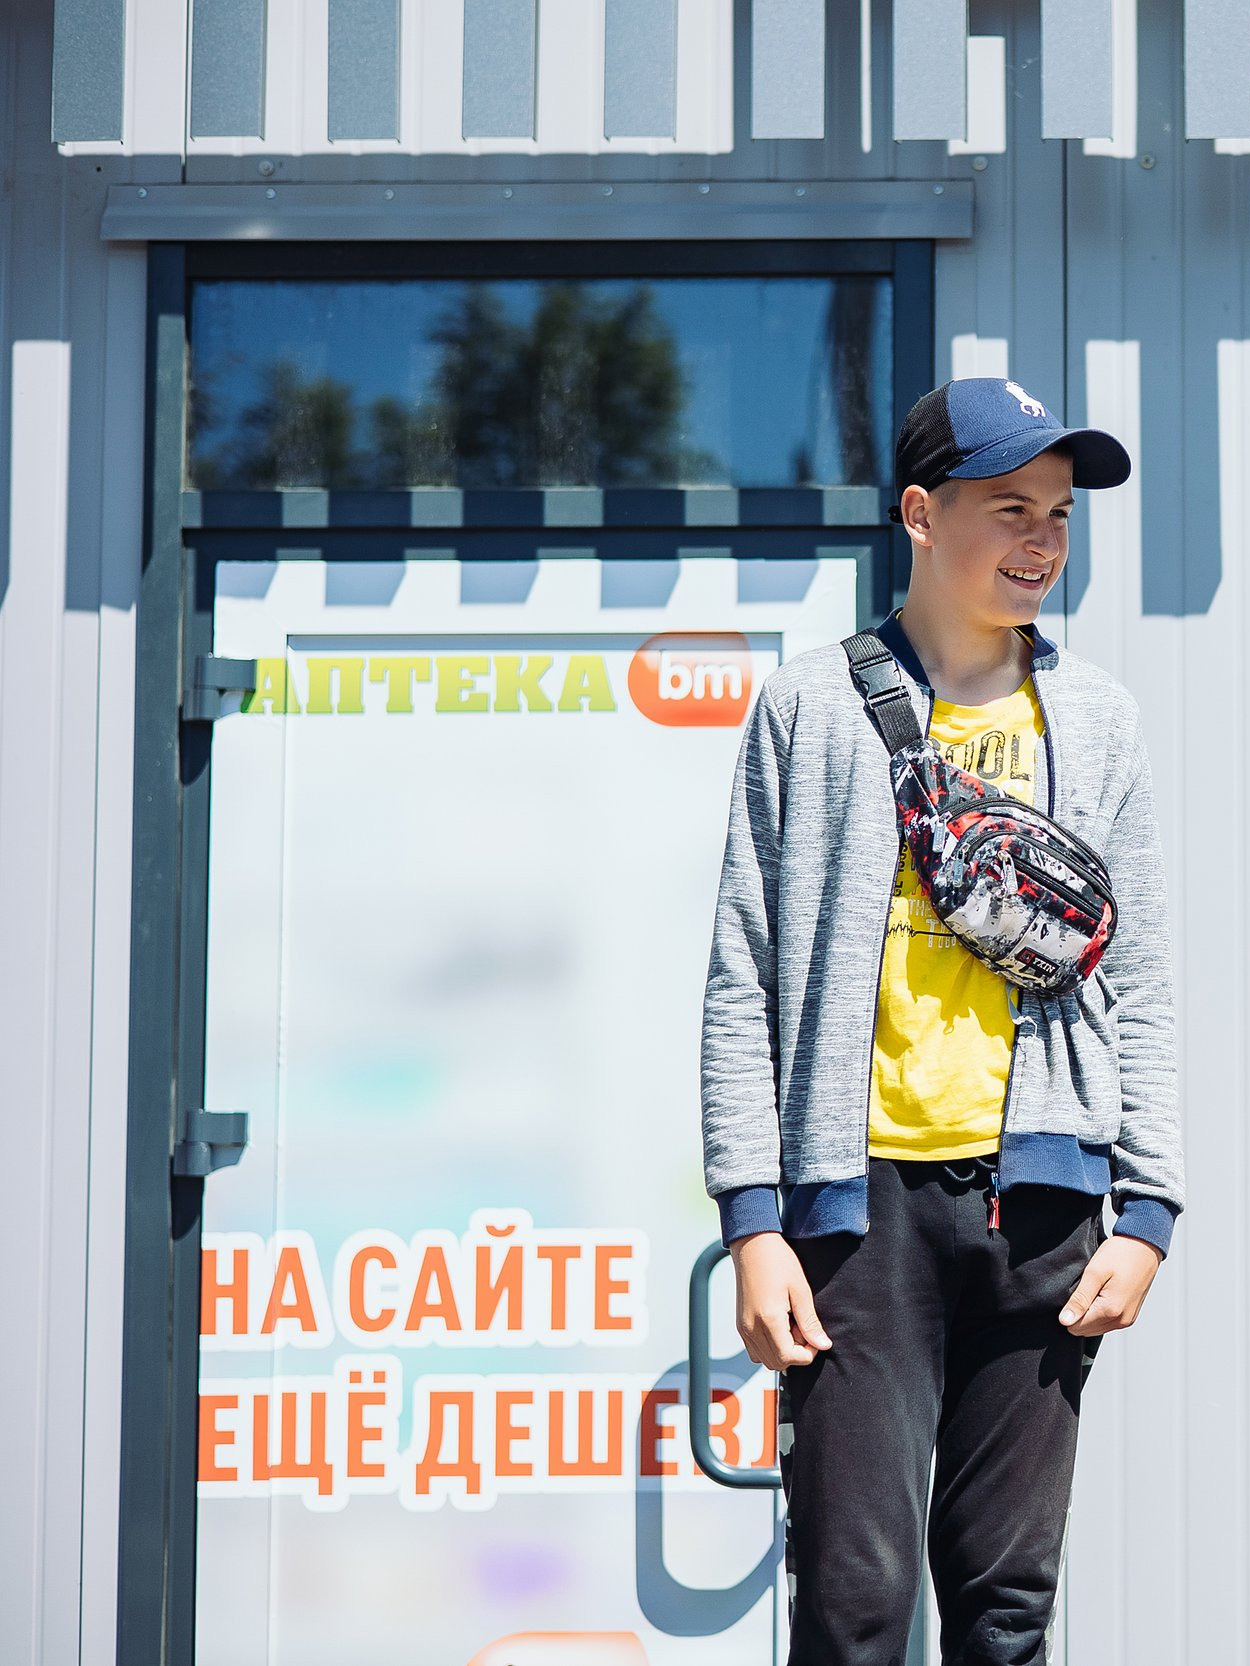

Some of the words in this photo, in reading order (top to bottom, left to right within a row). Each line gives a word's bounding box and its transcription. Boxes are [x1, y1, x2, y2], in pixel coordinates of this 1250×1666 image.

[241, 656, 616, 714] АПТЕКА
[658, 649, 743, 700] bm
[200, 1247, 318, 1336] НА
[348, 1225, 633, 1333] САЙТЕ
[197, 1371, 387, 1496] ЕЩЁ
